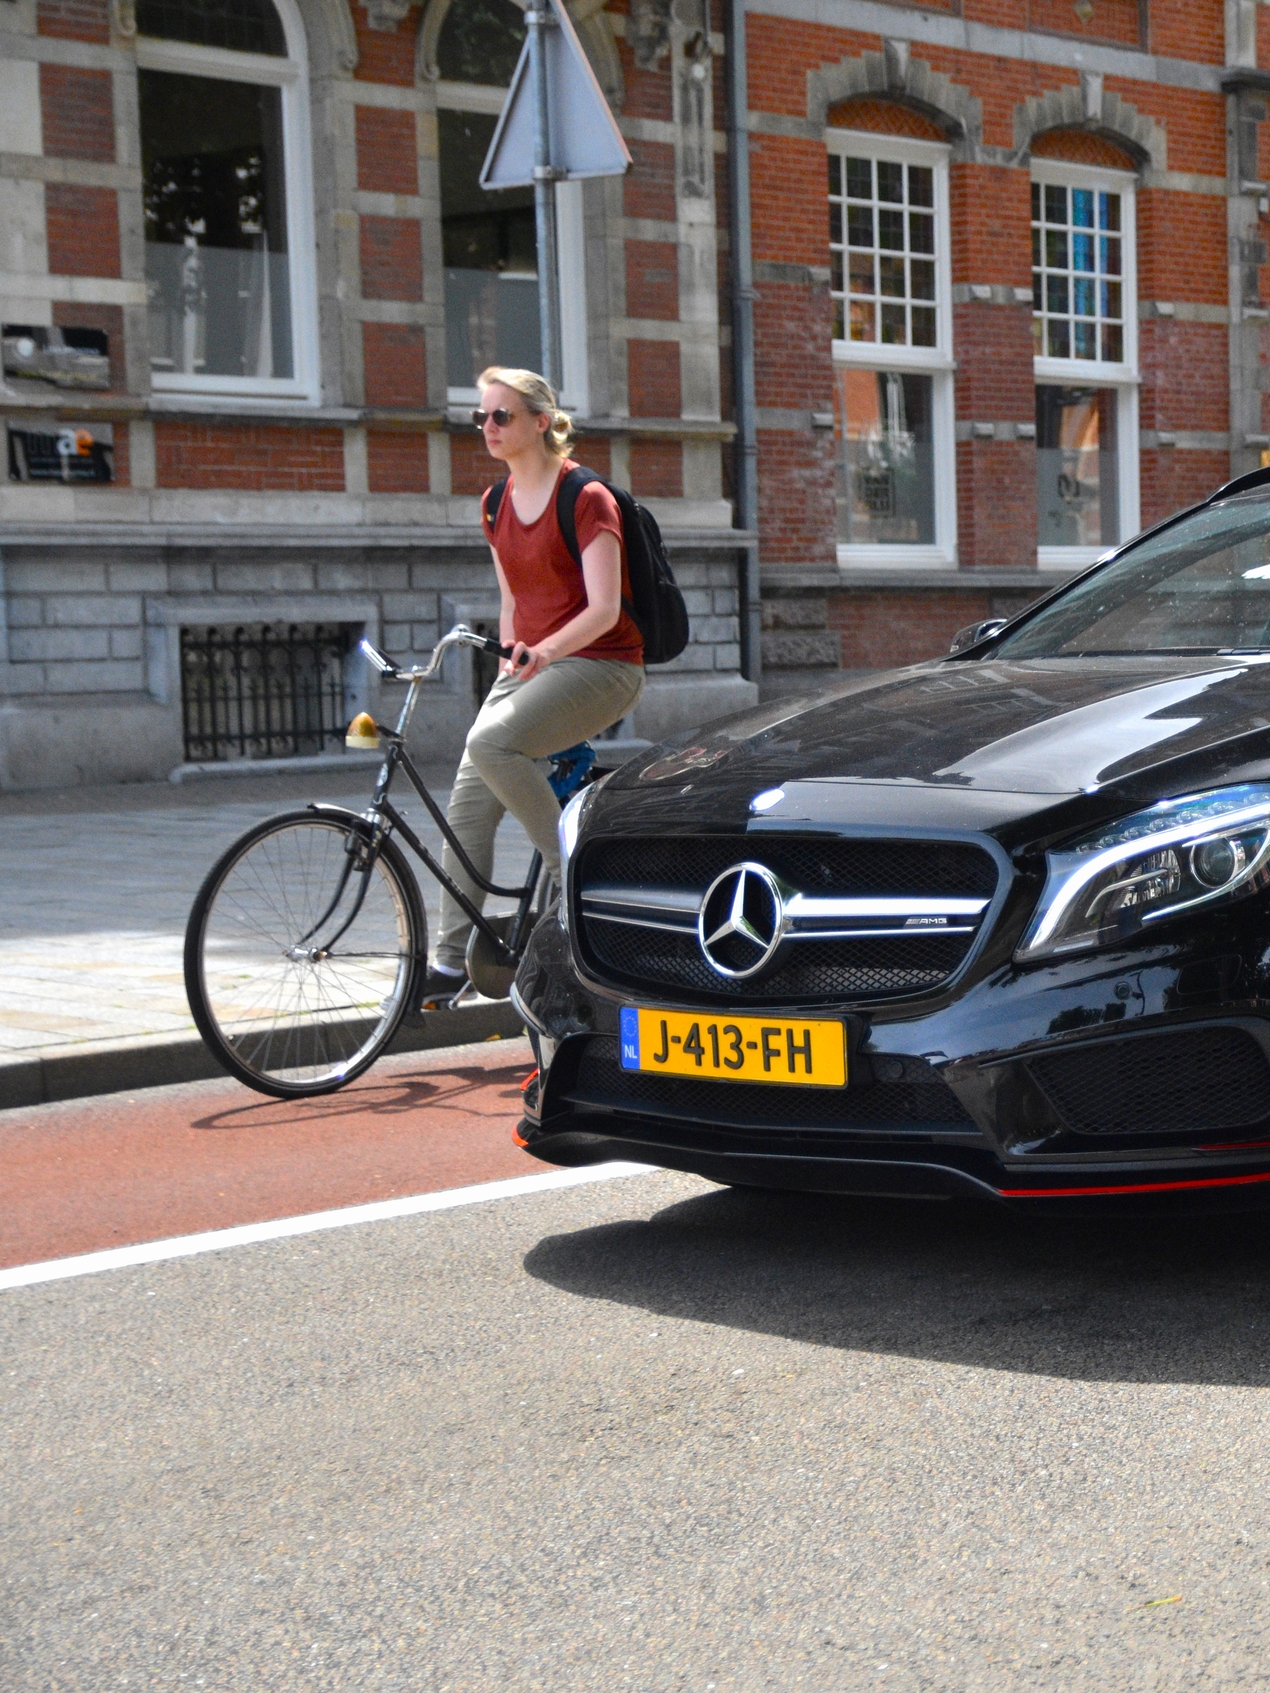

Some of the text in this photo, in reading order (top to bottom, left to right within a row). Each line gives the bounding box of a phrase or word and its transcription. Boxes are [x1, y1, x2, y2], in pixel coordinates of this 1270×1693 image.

[919, 917, 947, 925] AMG
[624, 1043, 638, 1060] NL
[653, 1019, 813, 1075] J-413-FH
